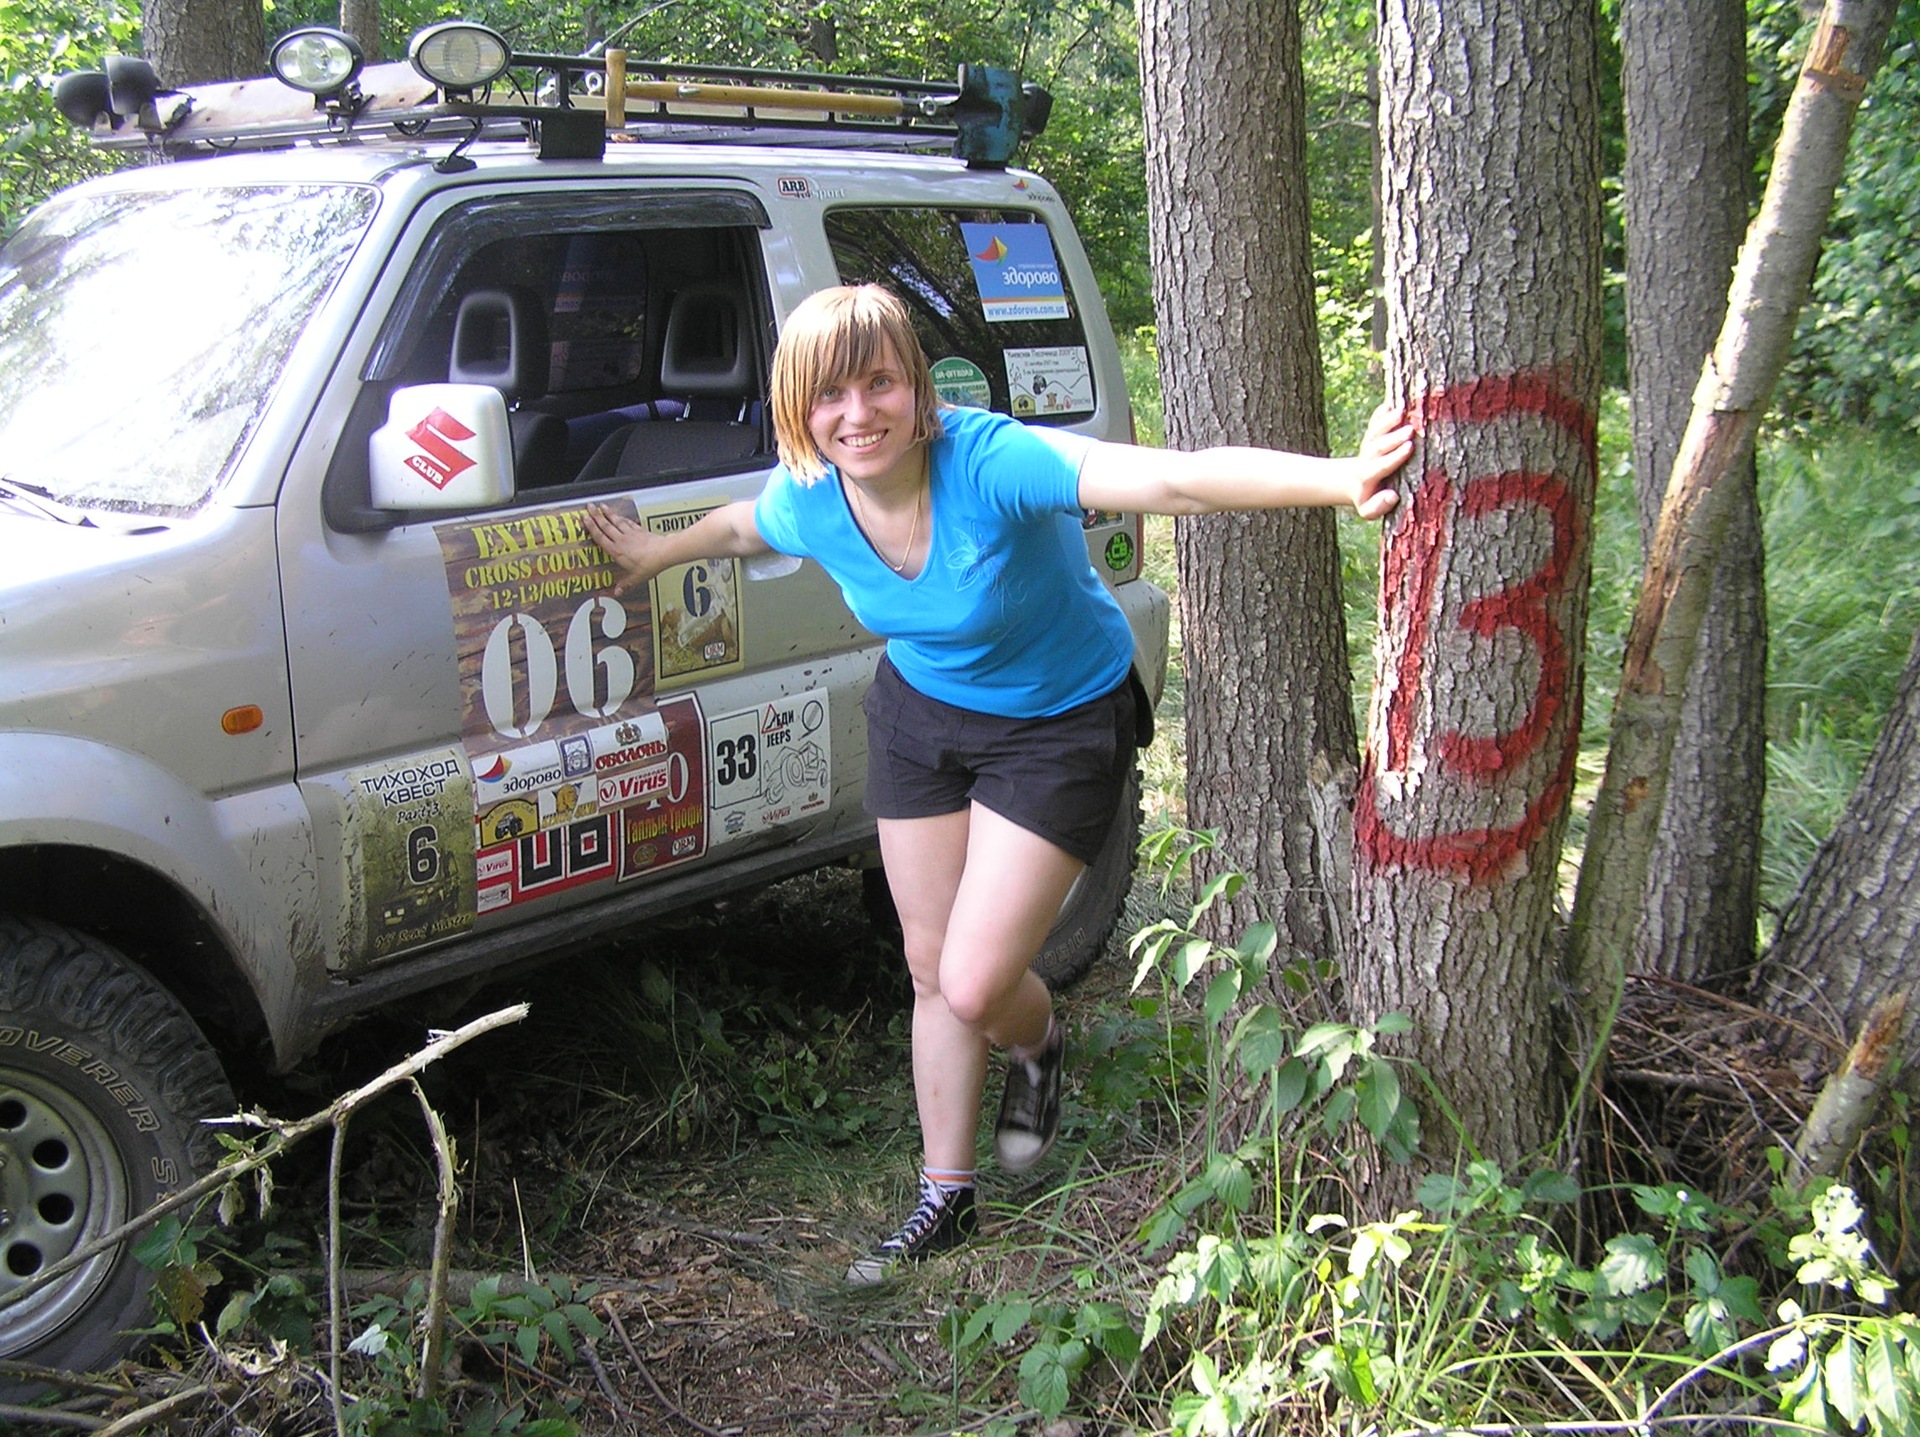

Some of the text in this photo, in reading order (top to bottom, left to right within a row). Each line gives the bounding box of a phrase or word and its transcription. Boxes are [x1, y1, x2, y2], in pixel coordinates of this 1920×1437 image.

[782, 180, 806, 192] ARB
[1002, 266, 1058, 289] здорово
[412, 457, 444, 485] CLUB
[471, 508, 606, 560] EXTRE
[464, 546, 616, 589] CROSS COUNTR
[492, 570, 613, 610] 12-13/06/2010
[683, 565, 712, 618] 6
[481, 596, 635, 739] 06
[766, 729, 792, 748] JEEPS
[360, 759, 461, 793] ТИХОХОД
[716, 733, 758, 786] 33
[382, 779, 446, 807] КВЕСТ
[503, 769, 562, 794] здорово
[619, 773, 668, 798] Virus
[408, 825, 438, 885] 6
